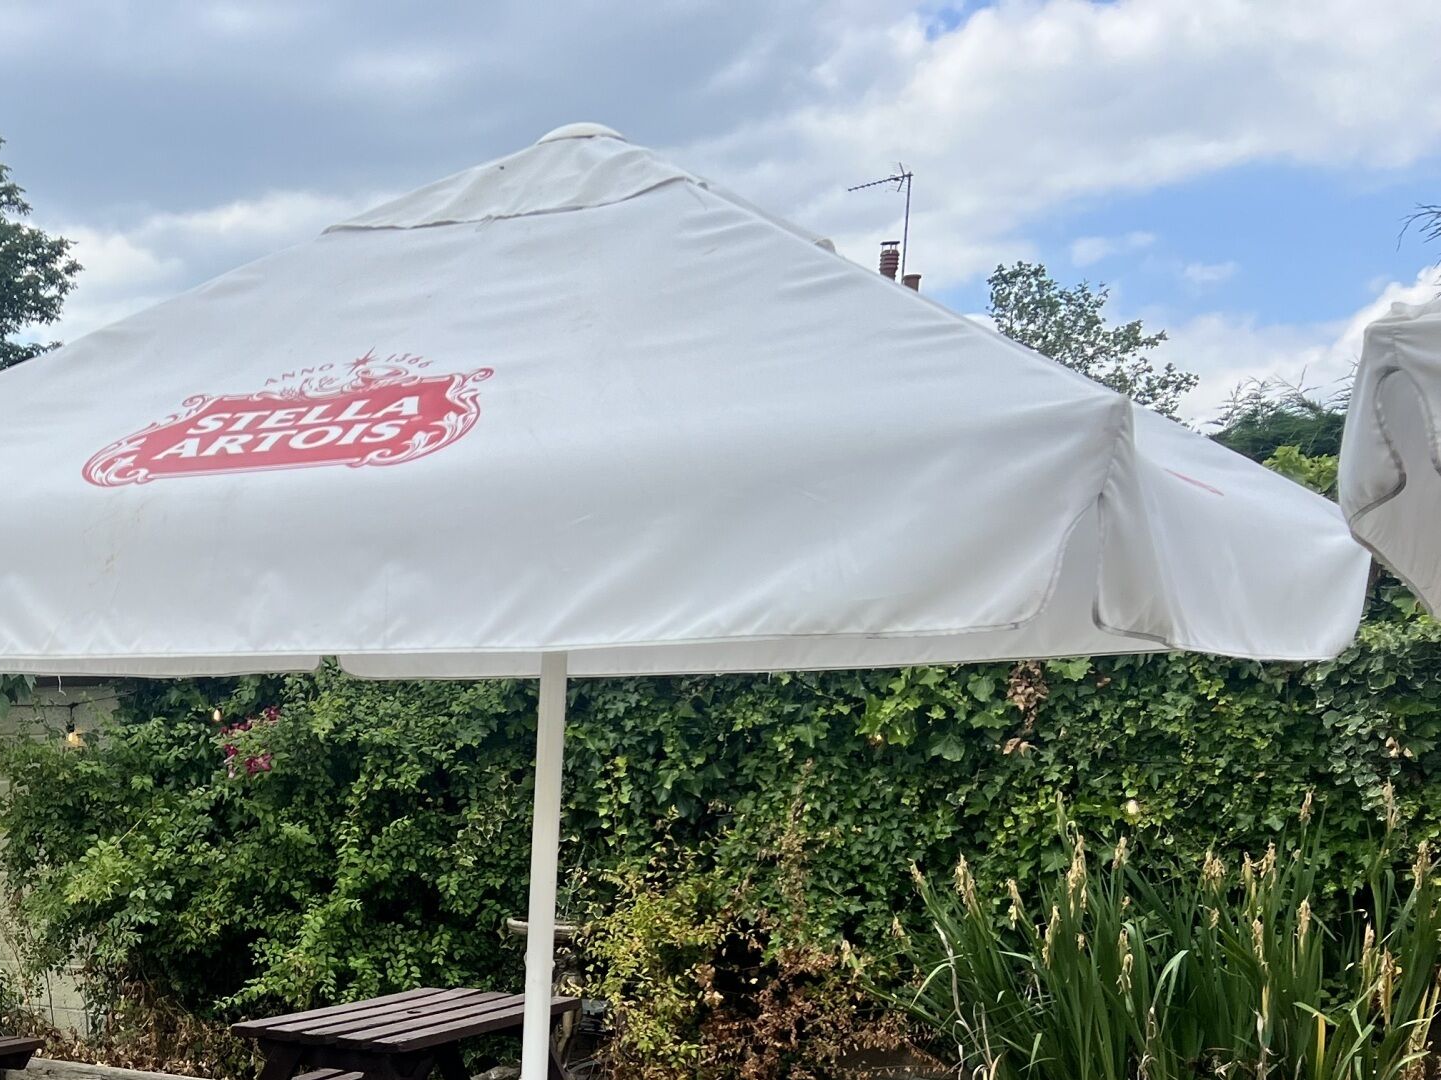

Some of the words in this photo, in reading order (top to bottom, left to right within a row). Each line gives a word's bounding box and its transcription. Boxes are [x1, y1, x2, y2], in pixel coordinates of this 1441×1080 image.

[264, 363, 334, 386] ANNO
[186, 396, 420, 435] STELLA
[151, 419, 408, 460] ARTOIS
